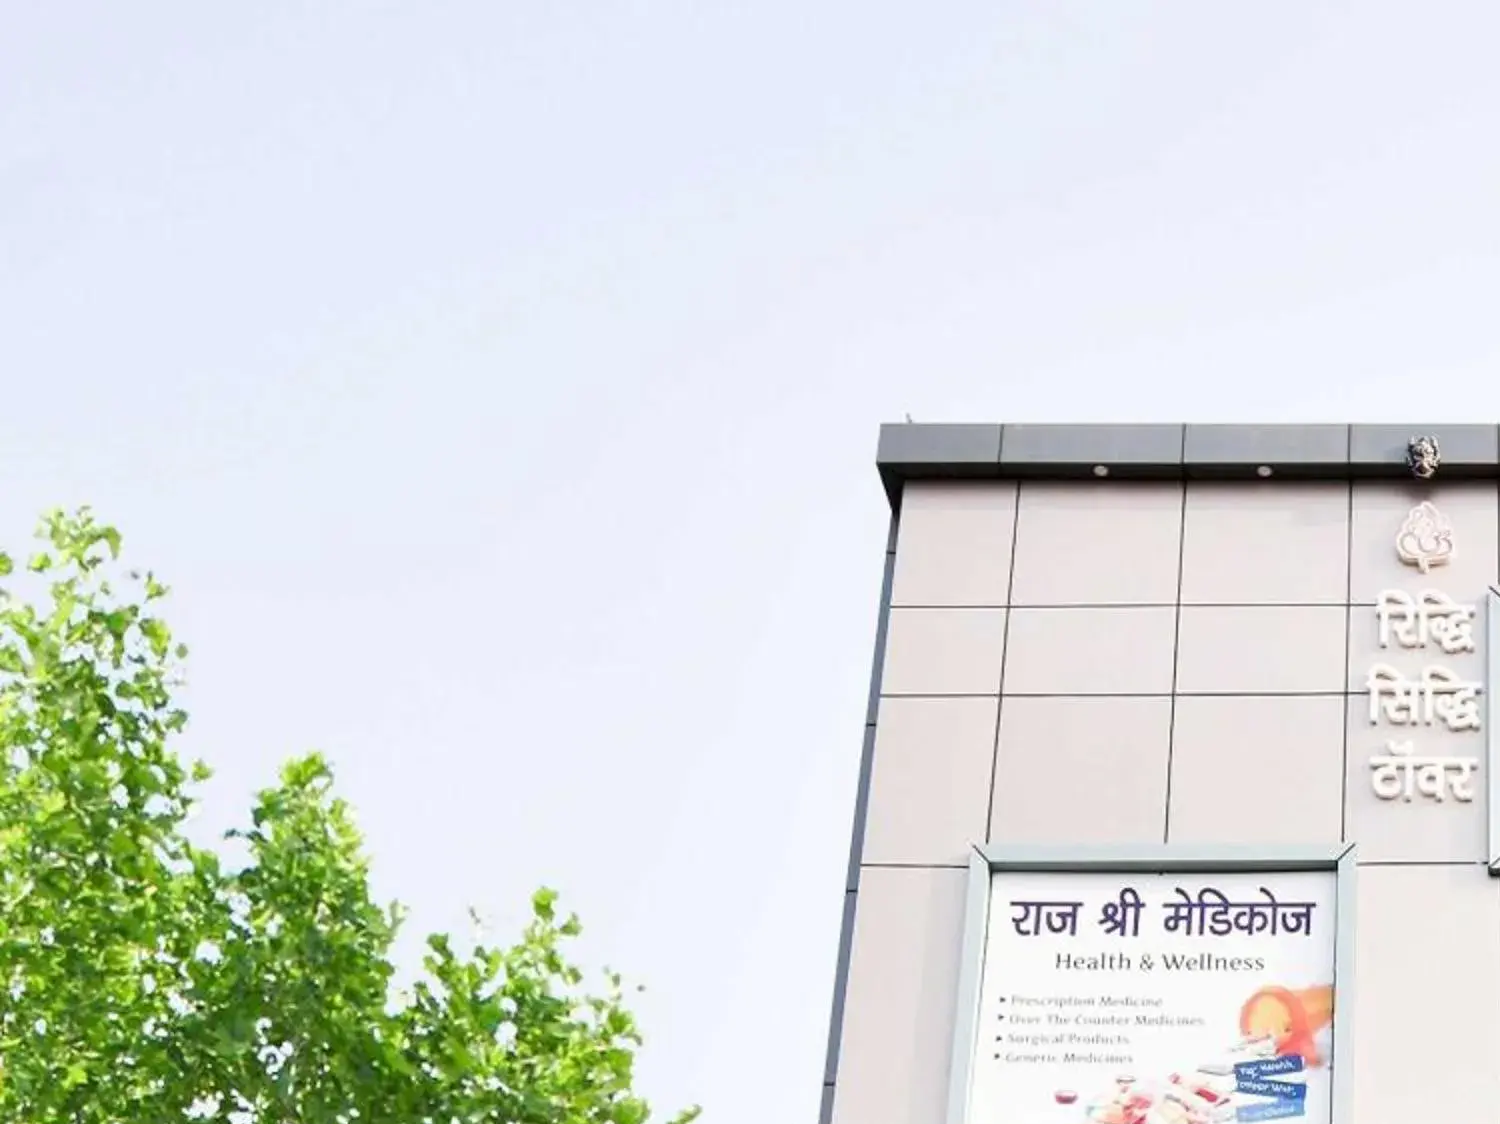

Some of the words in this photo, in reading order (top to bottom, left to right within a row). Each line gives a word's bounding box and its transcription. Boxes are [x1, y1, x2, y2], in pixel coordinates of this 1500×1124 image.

[1375, 588, 1476, 654] रिद्धि
[1365, 663, 1482, 732] सिद्धि
[1010, 900, 1084, 937] राज
[1097, 887, 1146, 937] श्री
[1162, 887, 1317, 937] मेडिकोज
[1055, 951, 1132, 972] Health
[1139, 954, 1155, 972] &
[1162, 952, 1265, 972] Wellness
[1011, 994, 1095, 1009] Prescription
[1099, 995, 1164, 1007] Medicine
[1009, 1014, 1041, 1026] Over
[1047, 1013, 1070, 1026] The
[1074, 1014, 1130, 1026] Counter
[1007, 1033, 1065, 1046] Surgical
[1068, 1033, 1130, 1045] Products
